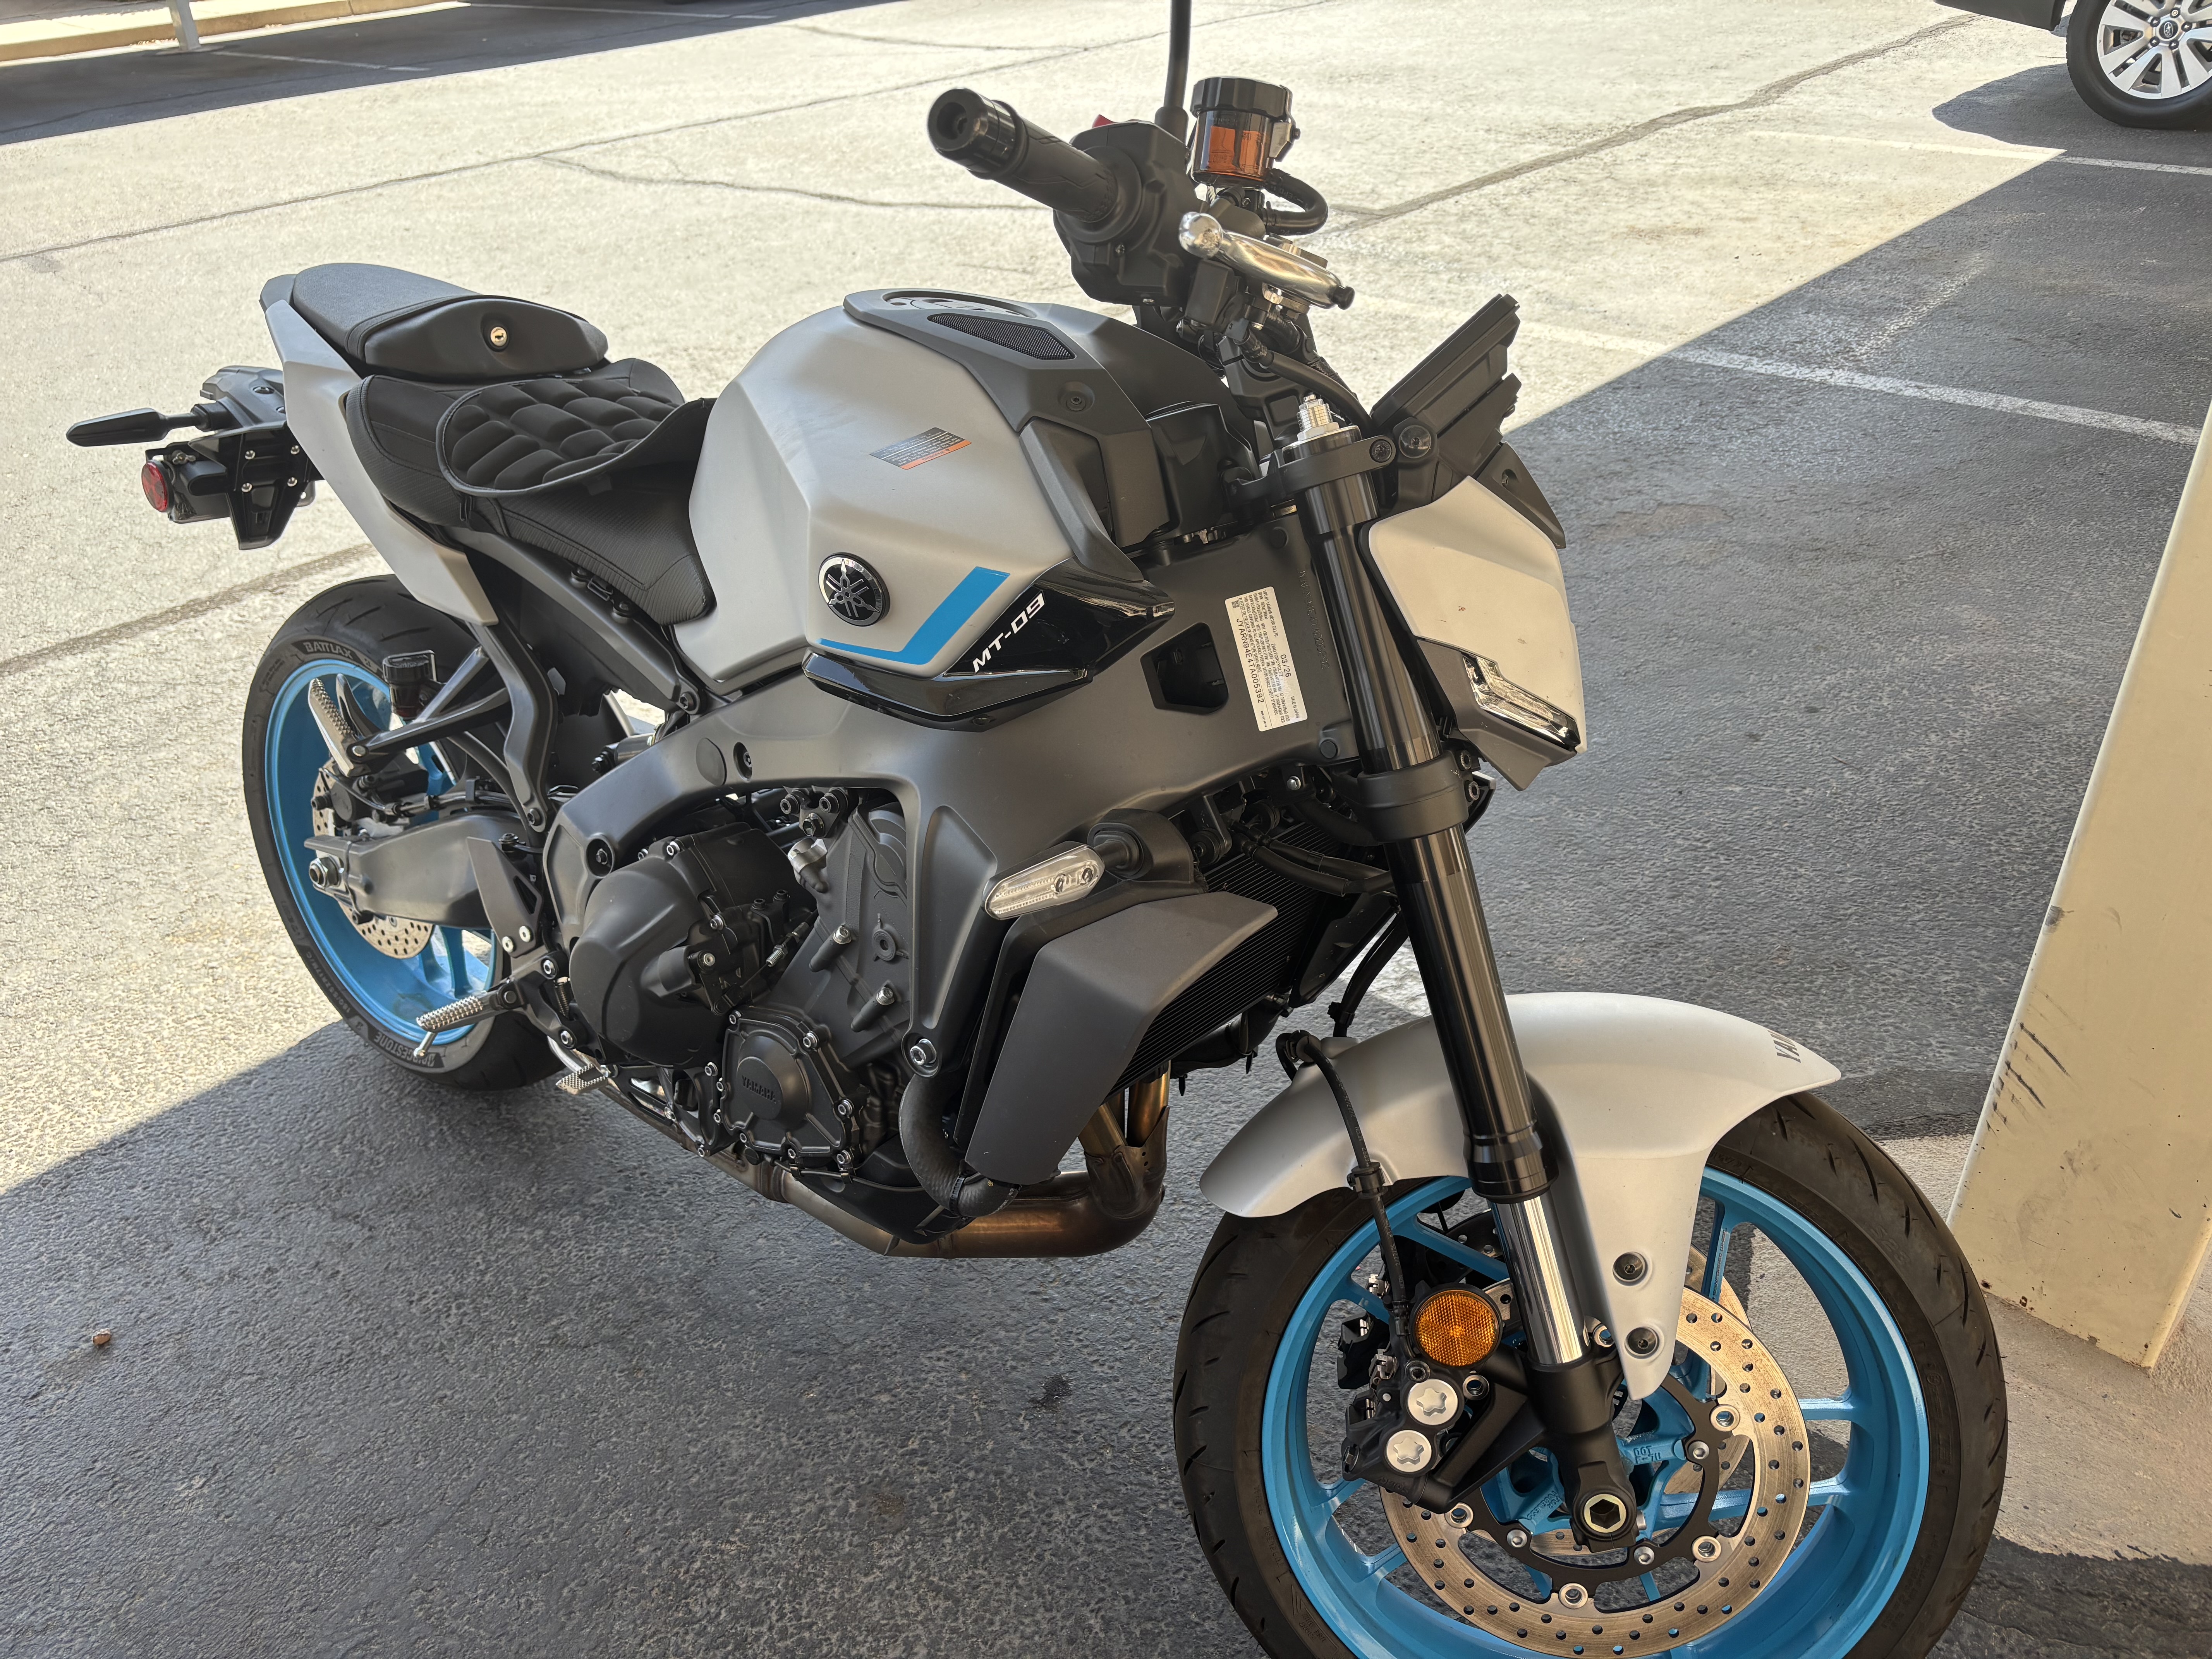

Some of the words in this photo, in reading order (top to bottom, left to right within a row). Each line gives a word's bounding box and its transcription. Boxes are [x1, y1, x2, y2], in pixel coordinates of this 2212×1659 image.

[972, 590, 1044, 673] MT-09
[303, 641, 354, 659] BATTLAX
[1236, 617, 1264, 703] JYARN94E4TA005392
[1279, 654, 1291, 677] 03/26
[741, 1075, 777, 1104] YAMAHA
[1633, 1446, 1651, 1456] DOT
[1527, 1490, 1556, 1519] TUBELESS
